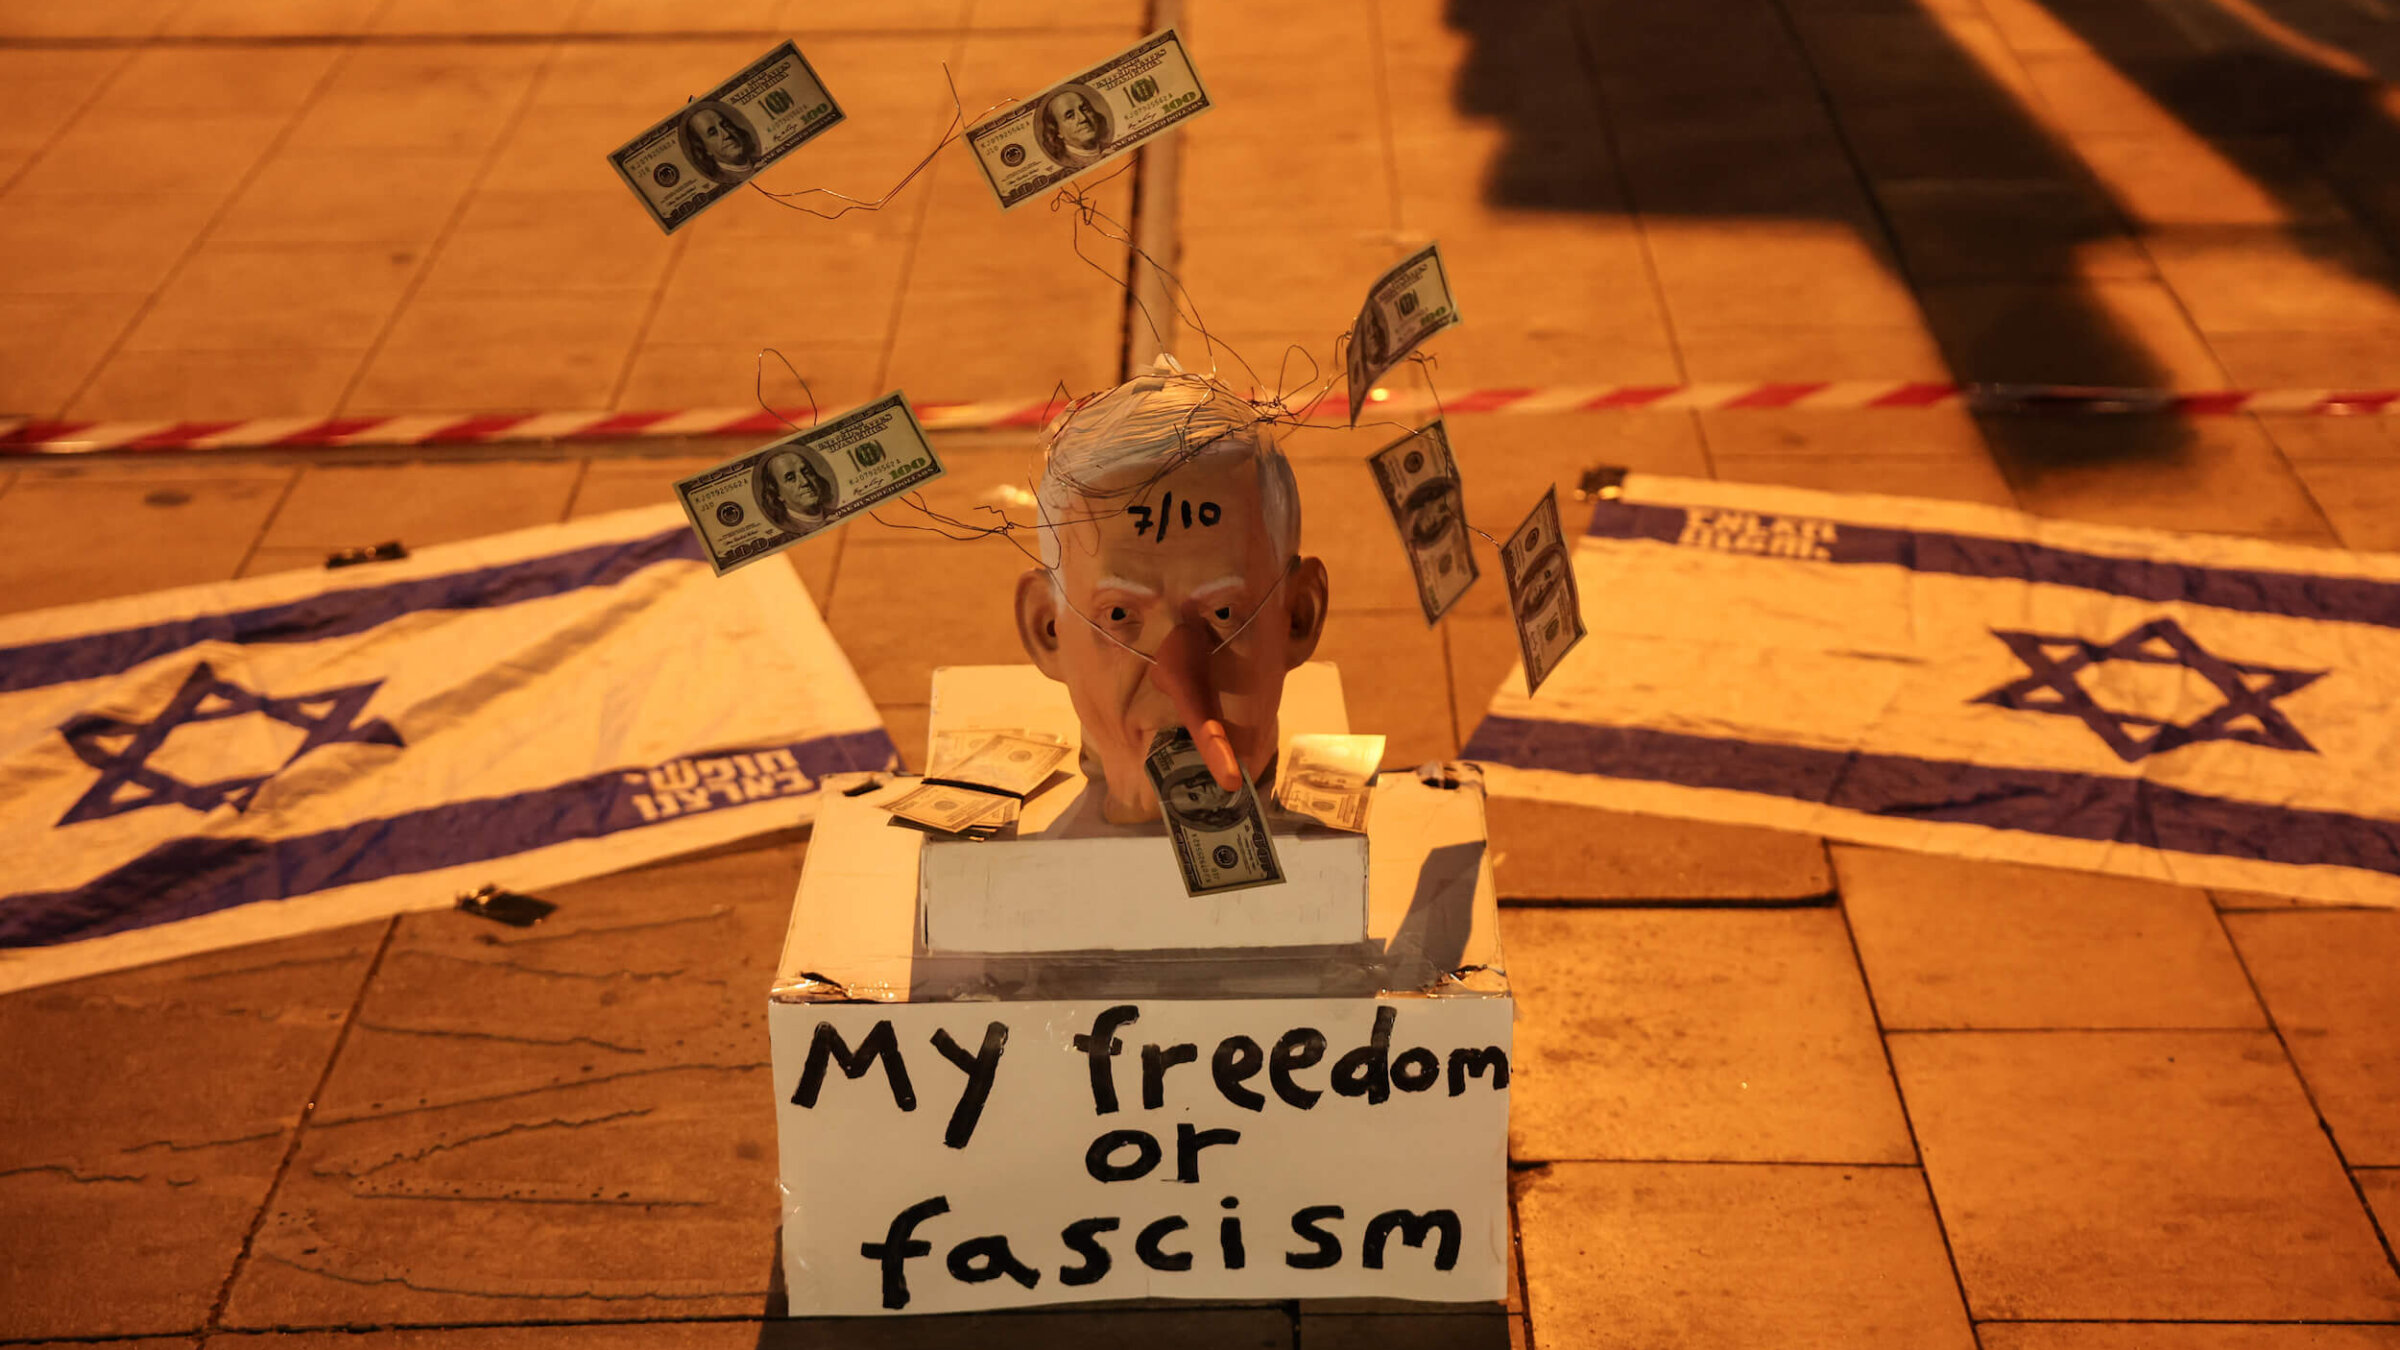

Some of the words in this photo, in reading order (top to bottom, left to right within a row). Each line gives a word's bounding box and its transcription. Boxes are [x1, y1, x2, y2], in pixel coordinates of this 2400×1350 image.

[799, 101, 829, 125] 100
[1160, 89, 1197, 114] 100
[1007, 172, 1050, 202] 100
[888, 456, 927, 480] 100
[1127, 490, 1222, 544] 7/10
[722, 534, 770, 565] 100
[630, 768, 816, 821] בארצנו
[790, 1019, 1009, 1148] My
[1073, 1004, 1510, 1116] freedom
[1084, 1122, 1241, 1184] or
[860, 1195, 1463, 1310] fascism
